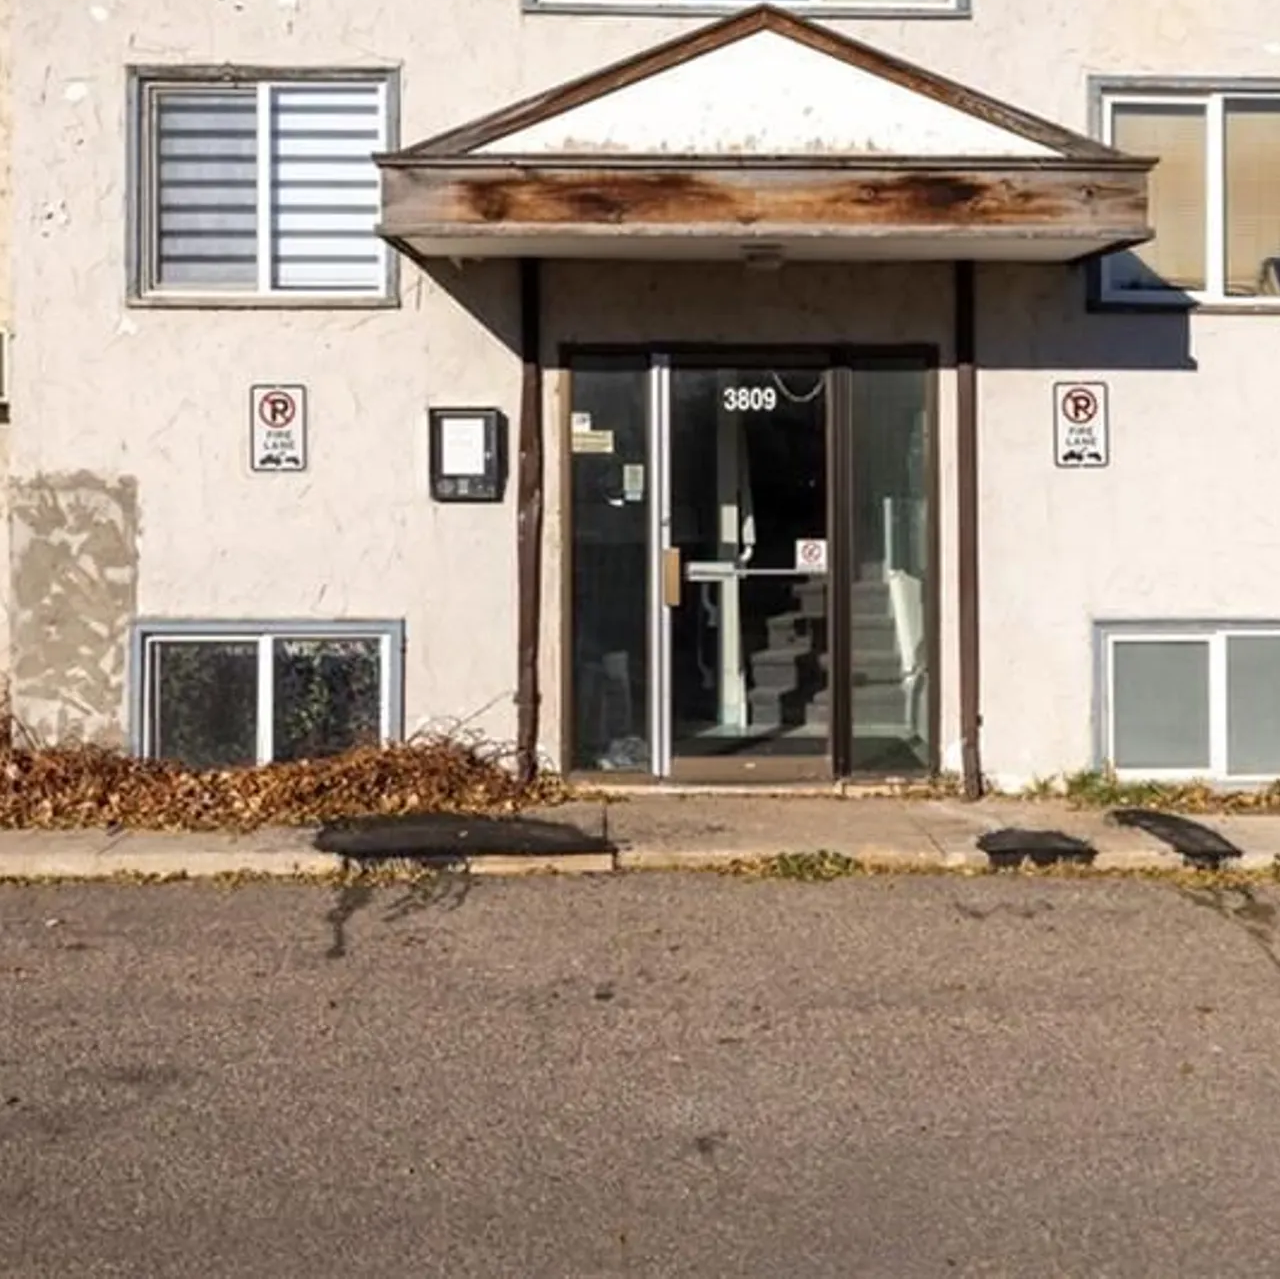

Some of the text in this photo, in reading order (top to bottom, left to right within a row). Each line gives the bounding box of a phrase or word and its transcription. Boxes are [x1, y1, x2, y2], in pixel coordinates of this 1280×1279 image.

[723, 386, 776, 410] 3809
[266, 430, 291, 439] FIRE
[1068, 426, 1093, 435] FIRE
[263, 440, 295, 450] LANE
[1064, 437, 1097, 446] LANE
